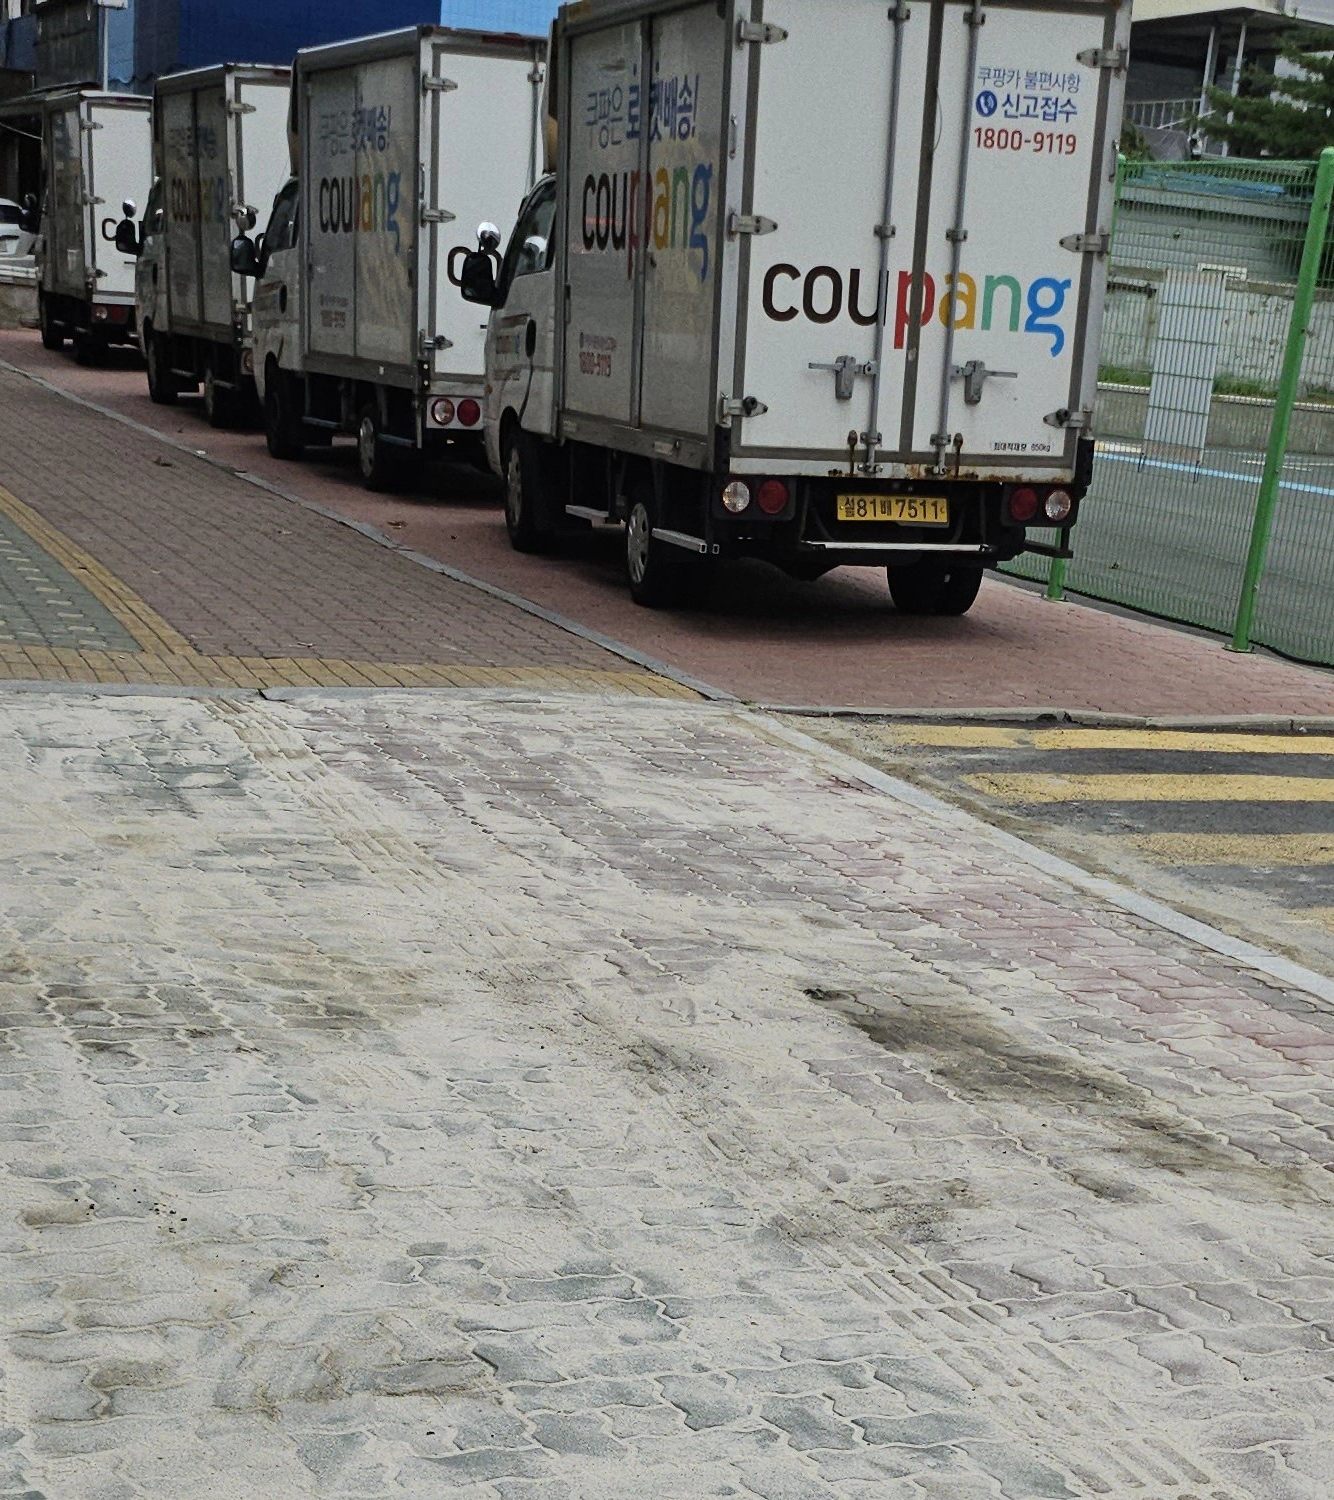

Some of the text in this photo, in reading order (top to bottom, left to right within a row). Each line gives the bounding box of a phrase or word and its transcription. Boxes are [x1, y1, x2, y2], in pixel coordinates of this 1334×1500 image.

[978, 66, 1080, 94] 쿠팡카 불편사항
[1002, 94, 1078, 123] 신고접수
[974, 127, 1077, 155] 1800-9119
[582, 162, 713, 283] coupang
[762, 263, 1072, 357] coupang
